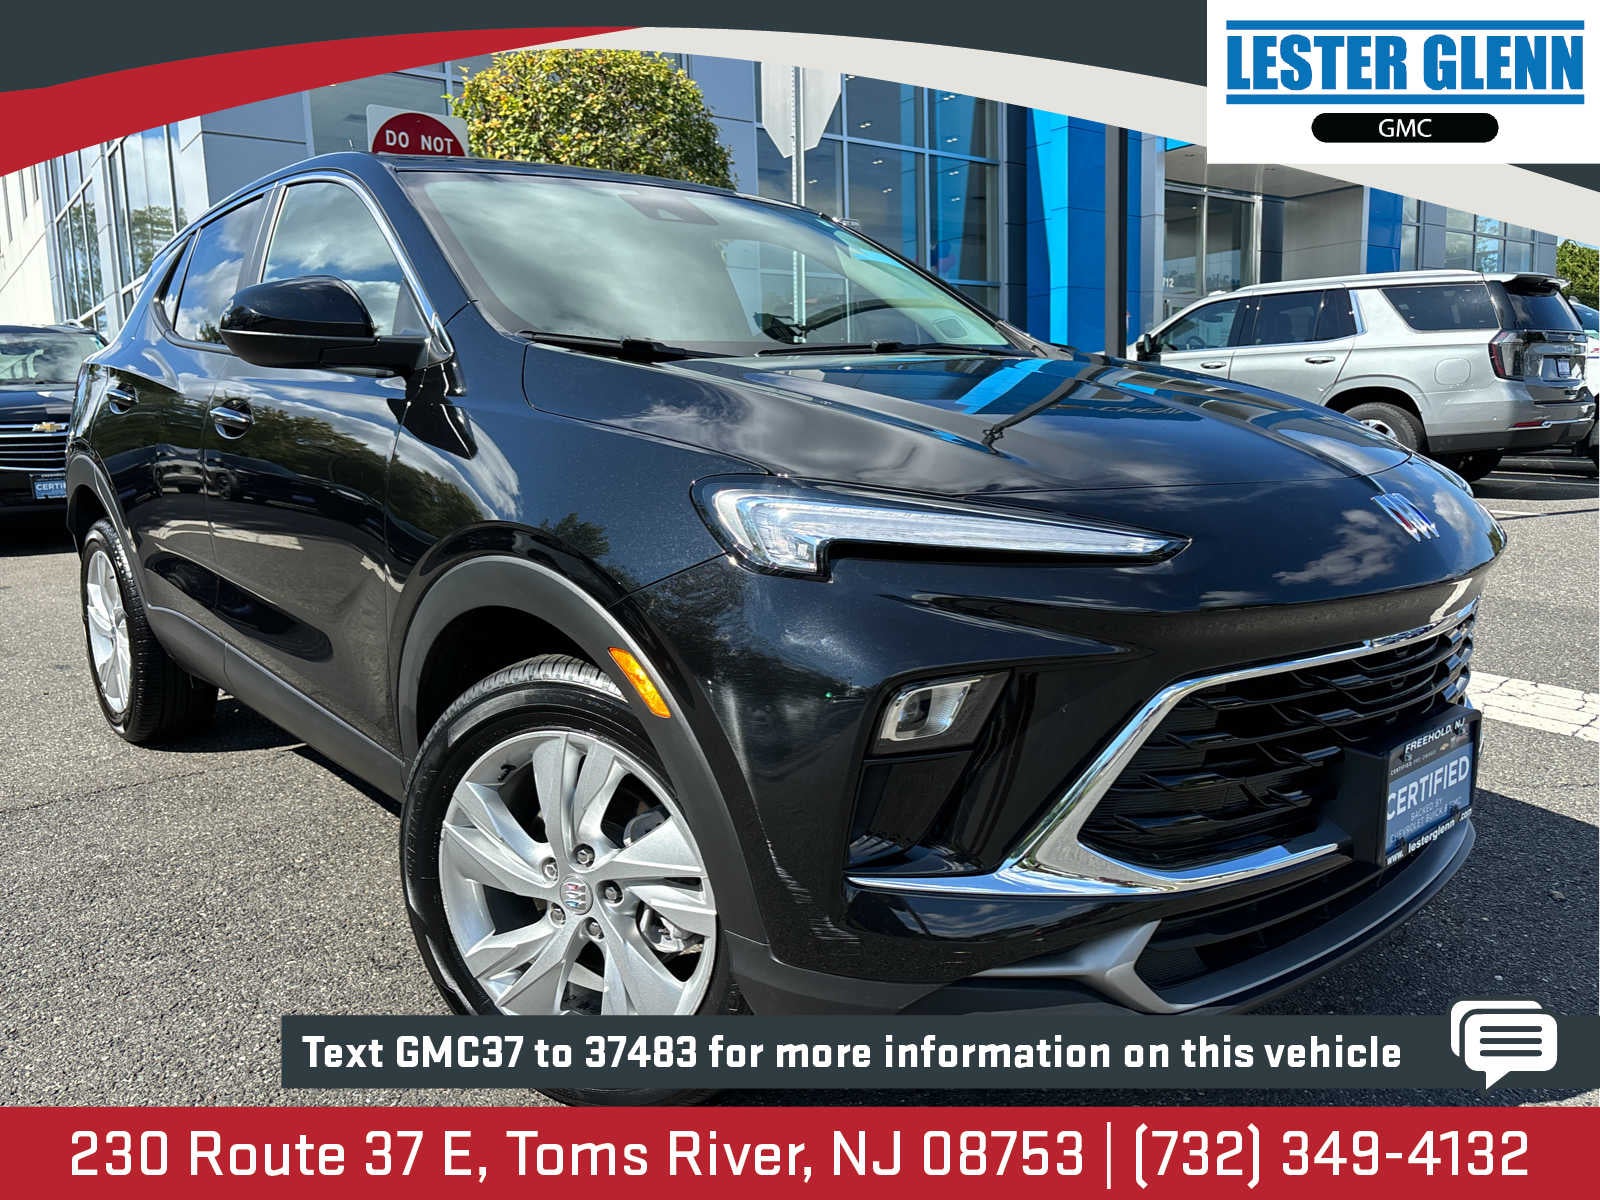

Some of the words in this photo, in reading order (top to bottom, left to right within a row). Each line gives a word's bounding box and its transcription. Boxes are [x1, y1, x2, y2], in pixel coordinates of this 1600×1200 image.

[385, 129, 410, 148] DO
[420, 134, 454, 154] NOT
[1454, 717, 1465, 730] NJ
[1386, 755, 1470, 820] CERTIFIED
